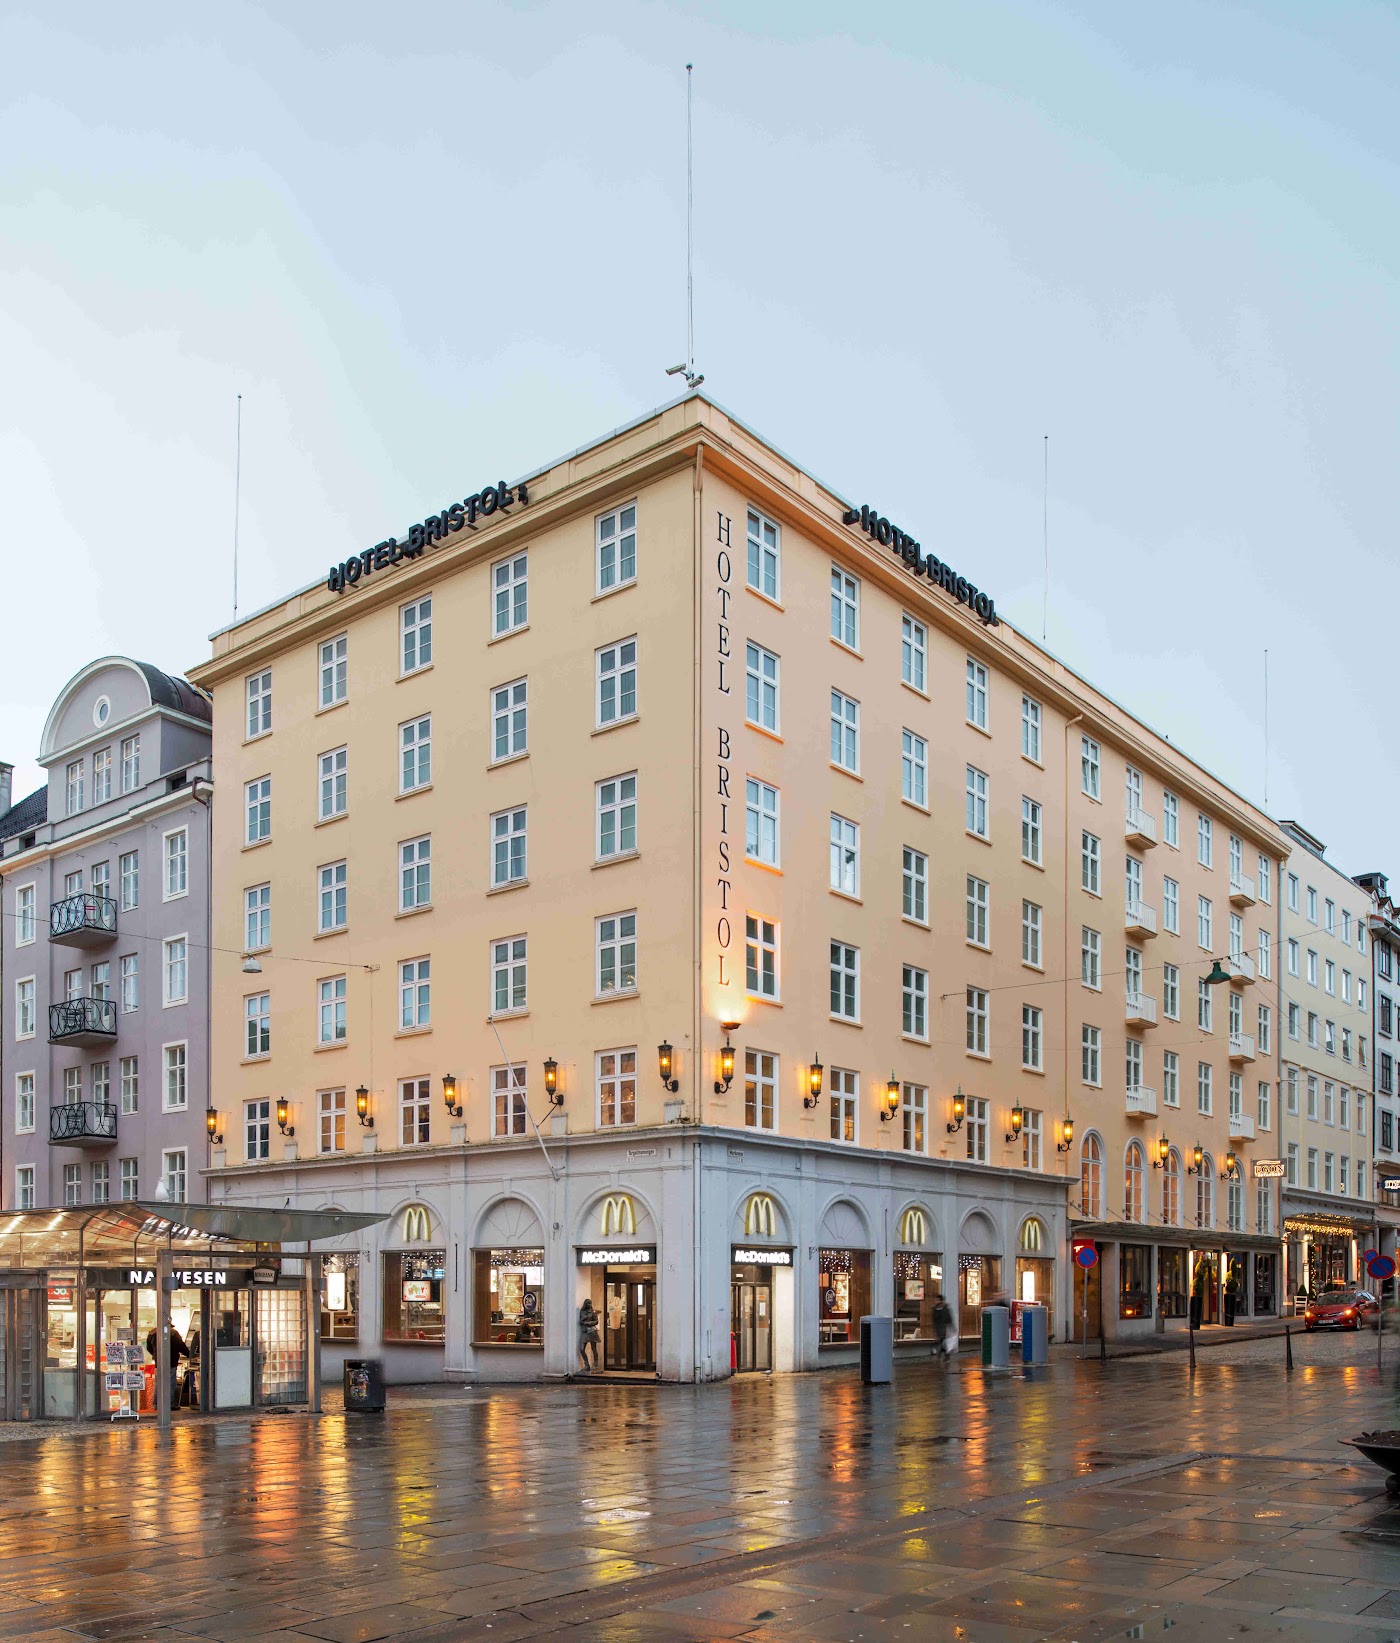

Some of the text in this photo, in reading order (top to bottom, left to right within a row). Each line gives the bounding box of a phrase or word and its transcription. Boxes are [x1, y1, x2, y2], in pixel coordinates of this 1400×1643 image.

[328, 480, 514, 591] HOTEL BRISTOL
[861, 504, 999, 627] HOTEL BRISTOL
[717, 511, 732, 987] HOTEL BRISTOL
[1254, 1164, 1285, 1174] EGON
[581, 1249, 650, 1264] McDonald's
[735, 1249, 790, 1264] McDonald's
[130, 1270, 227, 1285] NAVESEN
